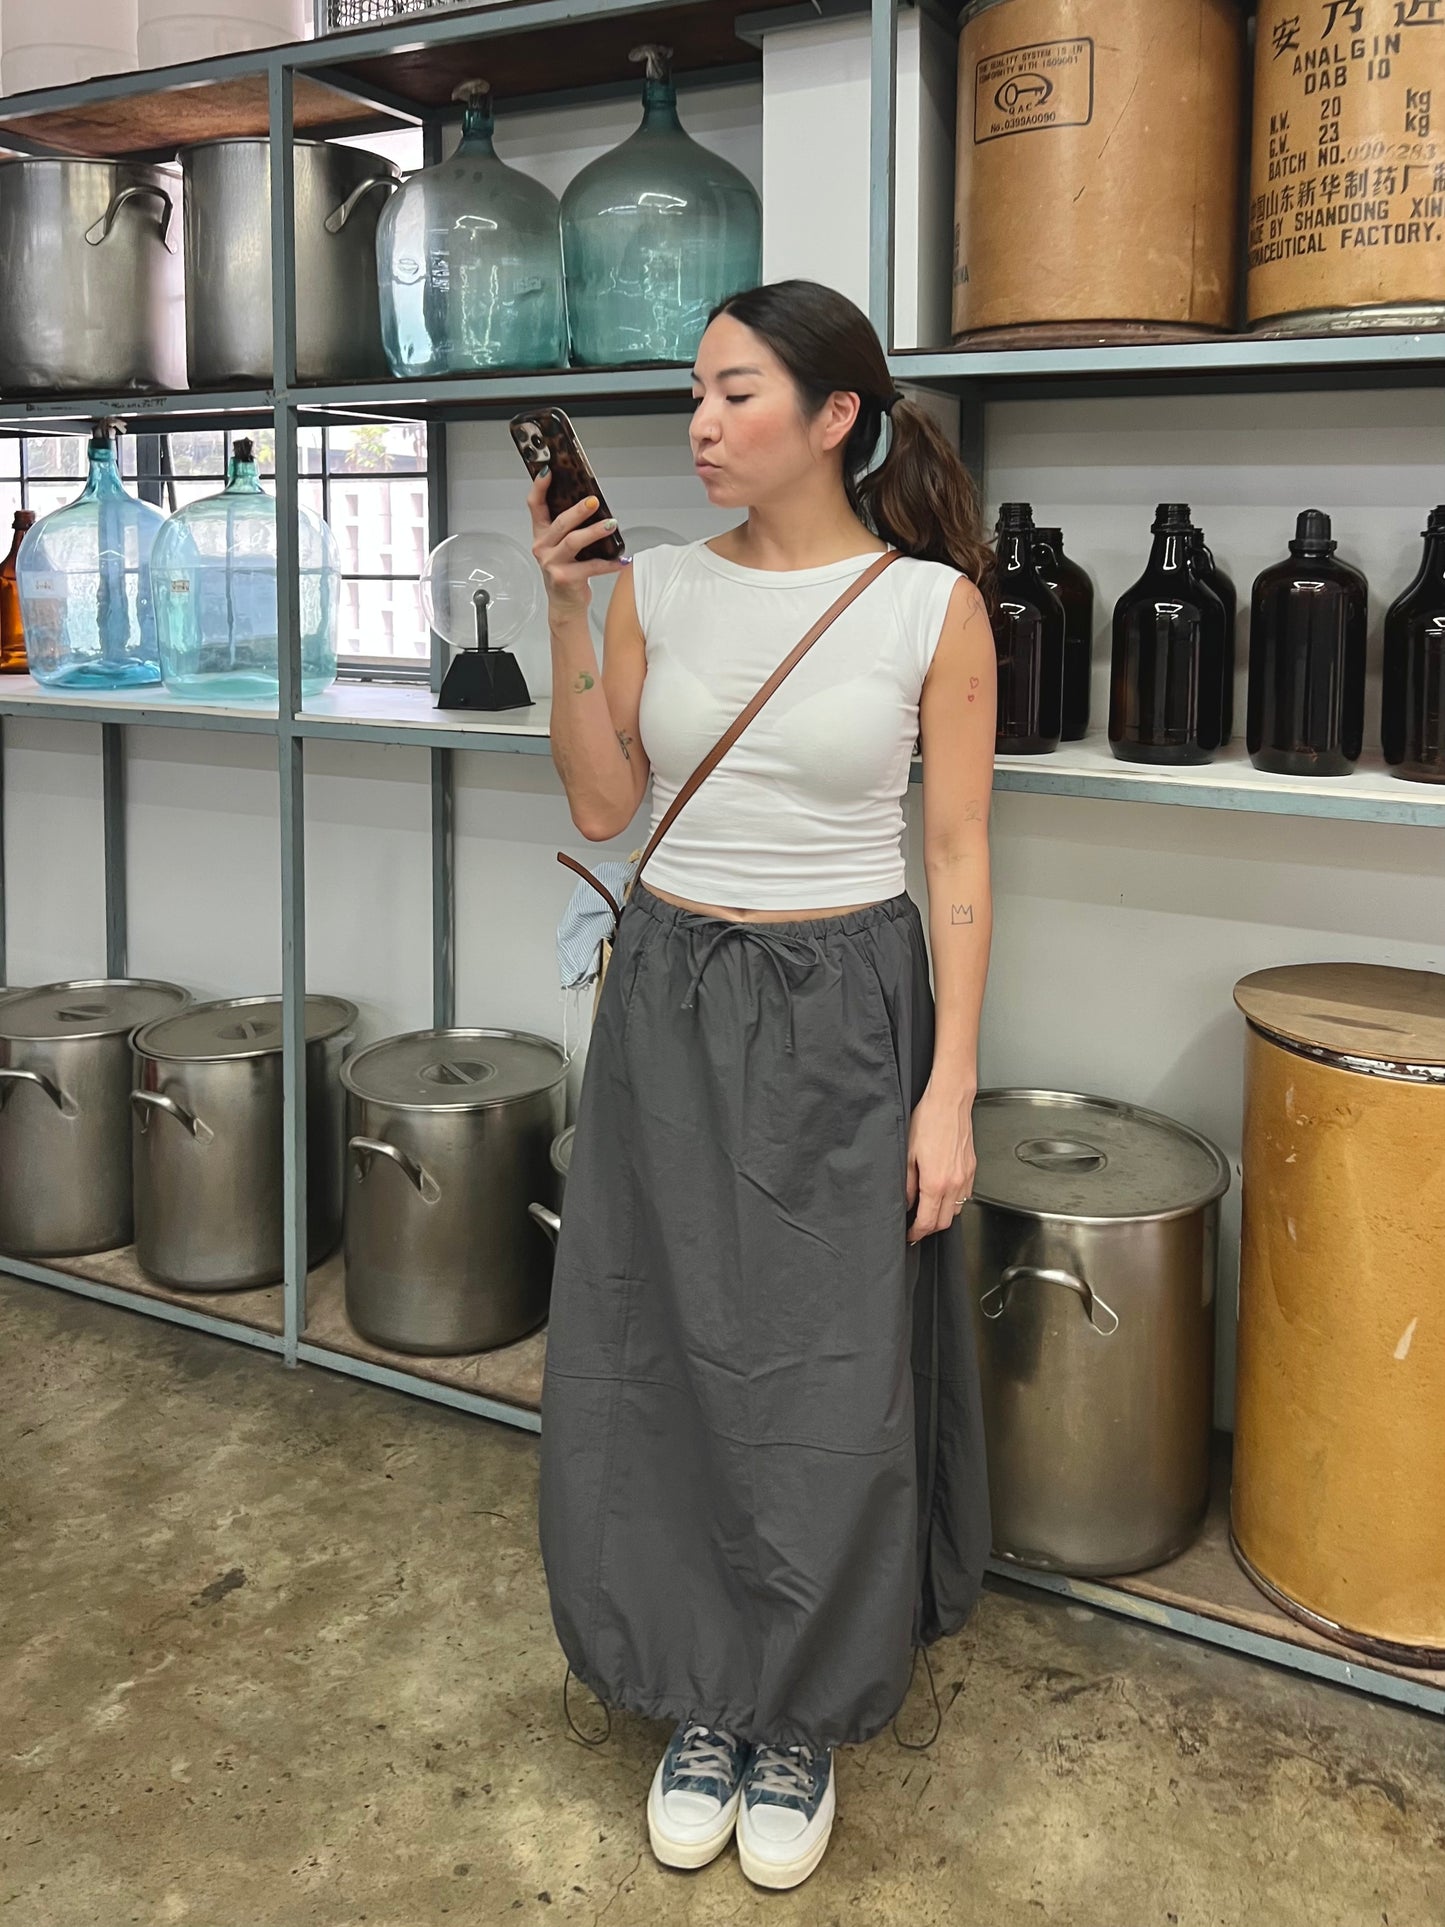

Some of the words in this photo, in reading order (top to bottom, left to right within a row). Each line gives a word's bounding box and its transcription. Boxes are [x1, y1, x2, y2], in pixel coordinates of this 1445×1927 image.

[1018, 62, 1037, 73] WITH
[1022, 49, 1051, 61] SYSTEM
[1292, 33, 1401, 75] ANALGIN
[1304, 65, 1347, 95] DAB
[1367, 58, 1391, 81] 10
[1270, 110, 1290, 135] N.W.
[1320, 96, 1341, 121] 20
[1406, 88, 1431, 114] kg
[1270, 134, 1290, 159] G.W.
[1319, 121, 1340, 145] 23
[1405, 111, 1430, 138] kg
[1268, 152, 1306, 181] BATCH
[1318, 145, 1345, 168] NO.
[1270, 217, 1283, 239] BY
[1295, 200, 1388, 231] SHANDONG
[1341, 222, 1441, 249] FACTORY.
